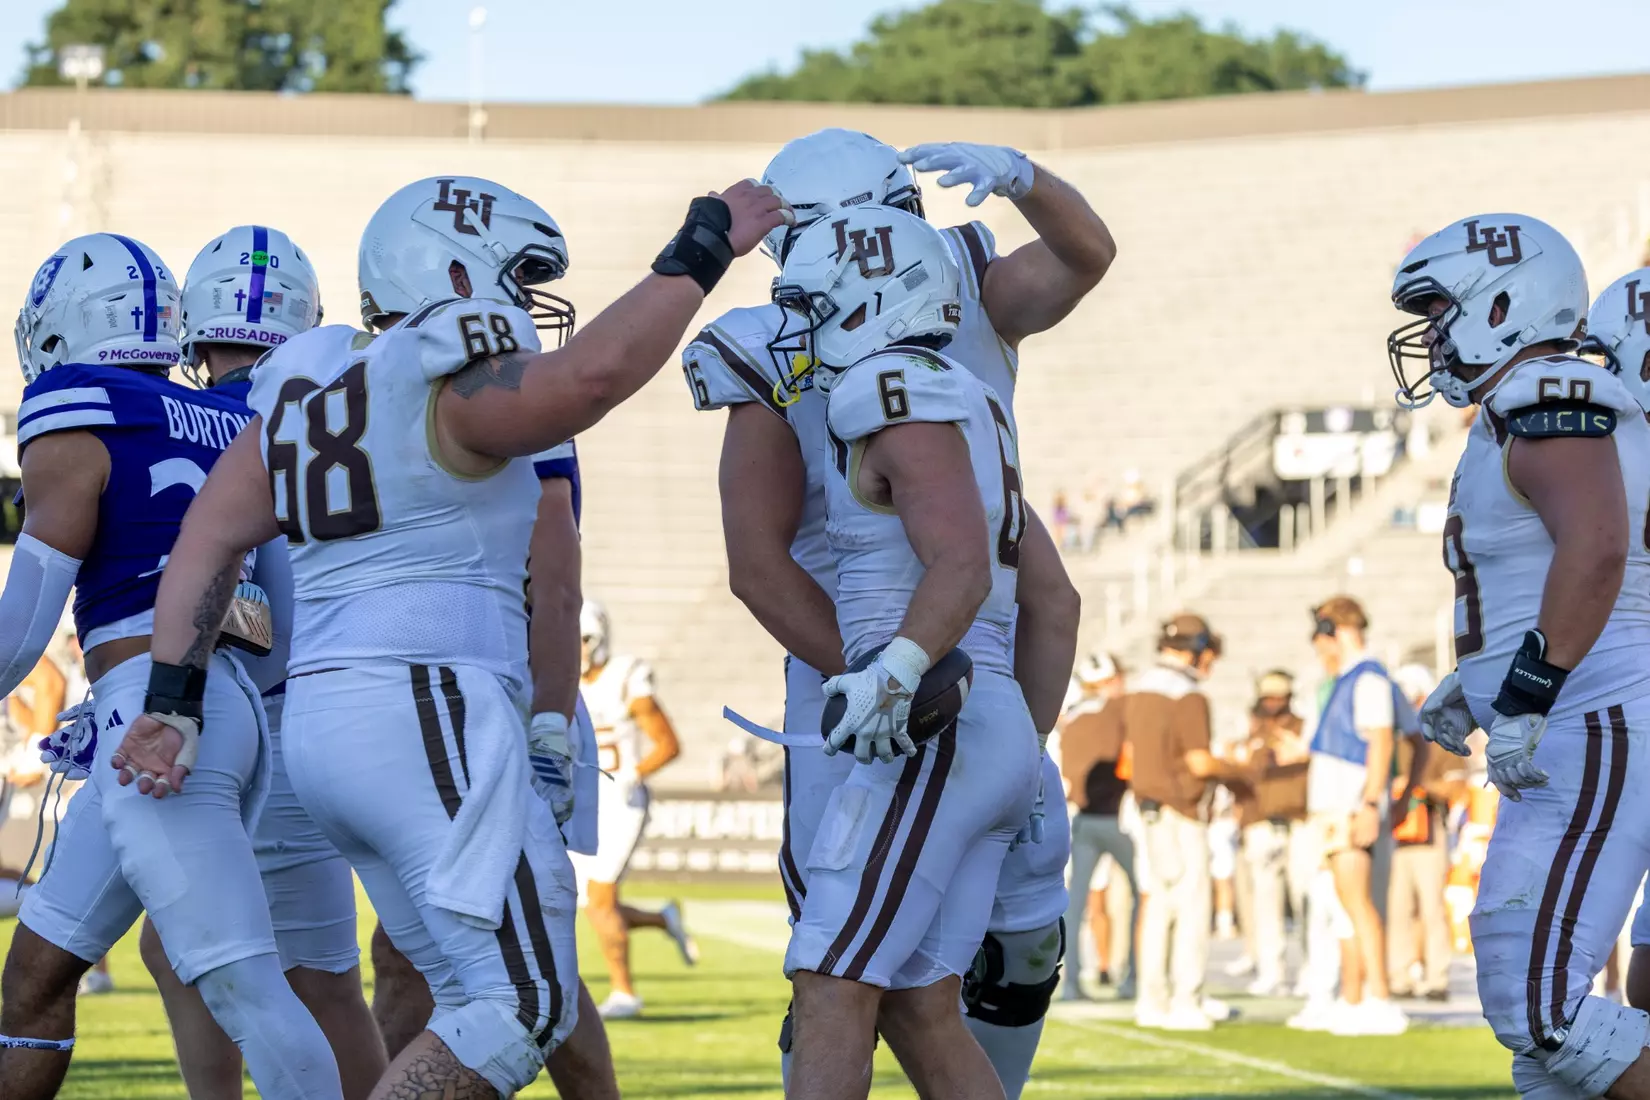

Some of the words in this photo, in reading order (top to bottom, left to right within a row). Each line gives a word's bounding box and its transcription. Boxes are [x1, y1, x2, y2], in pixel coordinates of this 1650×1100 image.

[433, 179, 497, 236] LU
[845, 194, 869, 206] LEHIGH
[831, 218, 895, 280] LU
[1463, 219, 1523, 267] LU
[458, 312, 519, 361] 68
[877, 368, 912, 421] 6
[266, 361, 381, 546] 68
[1515, 667, 1549, 686] MUELLER
